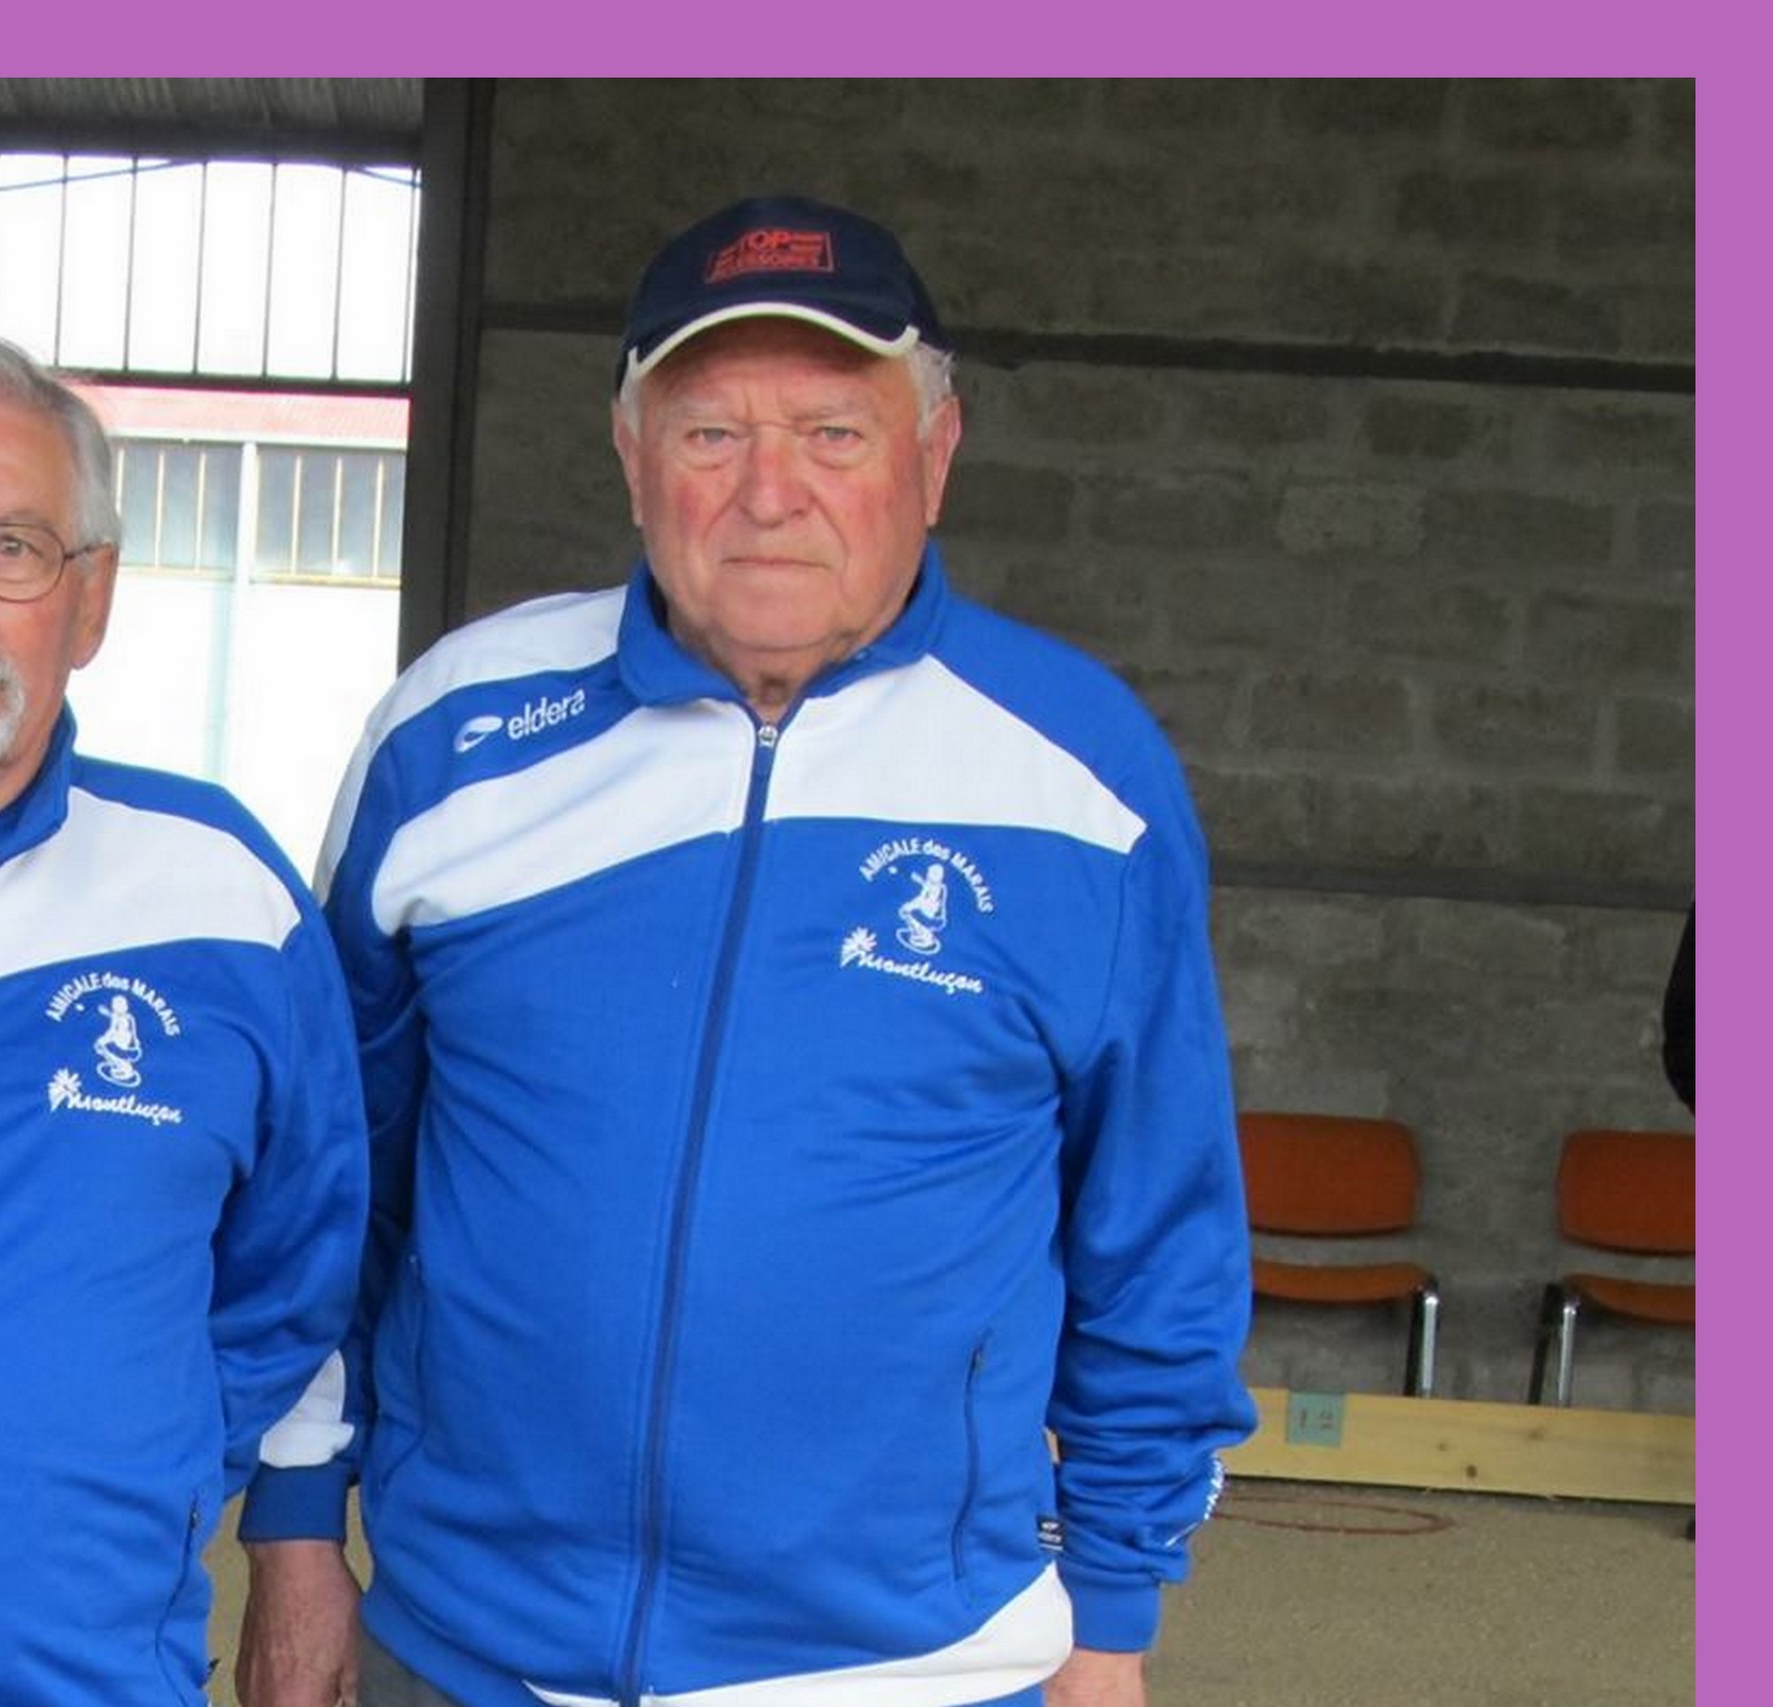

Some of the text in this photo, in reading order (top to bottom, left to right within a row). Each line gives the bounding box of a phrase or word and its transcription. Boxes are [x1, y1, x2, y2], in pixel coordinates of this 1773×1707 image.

[508, 688, 585, 740] eldera
[859, 837, 994, 913] AMICALE des MARAIS
[841, 950, 984, 995] Montluçon
[45, 971, 181, 1037] AMICALE des MARAIS
[50, 1091, 183, 1127] Montluçon
